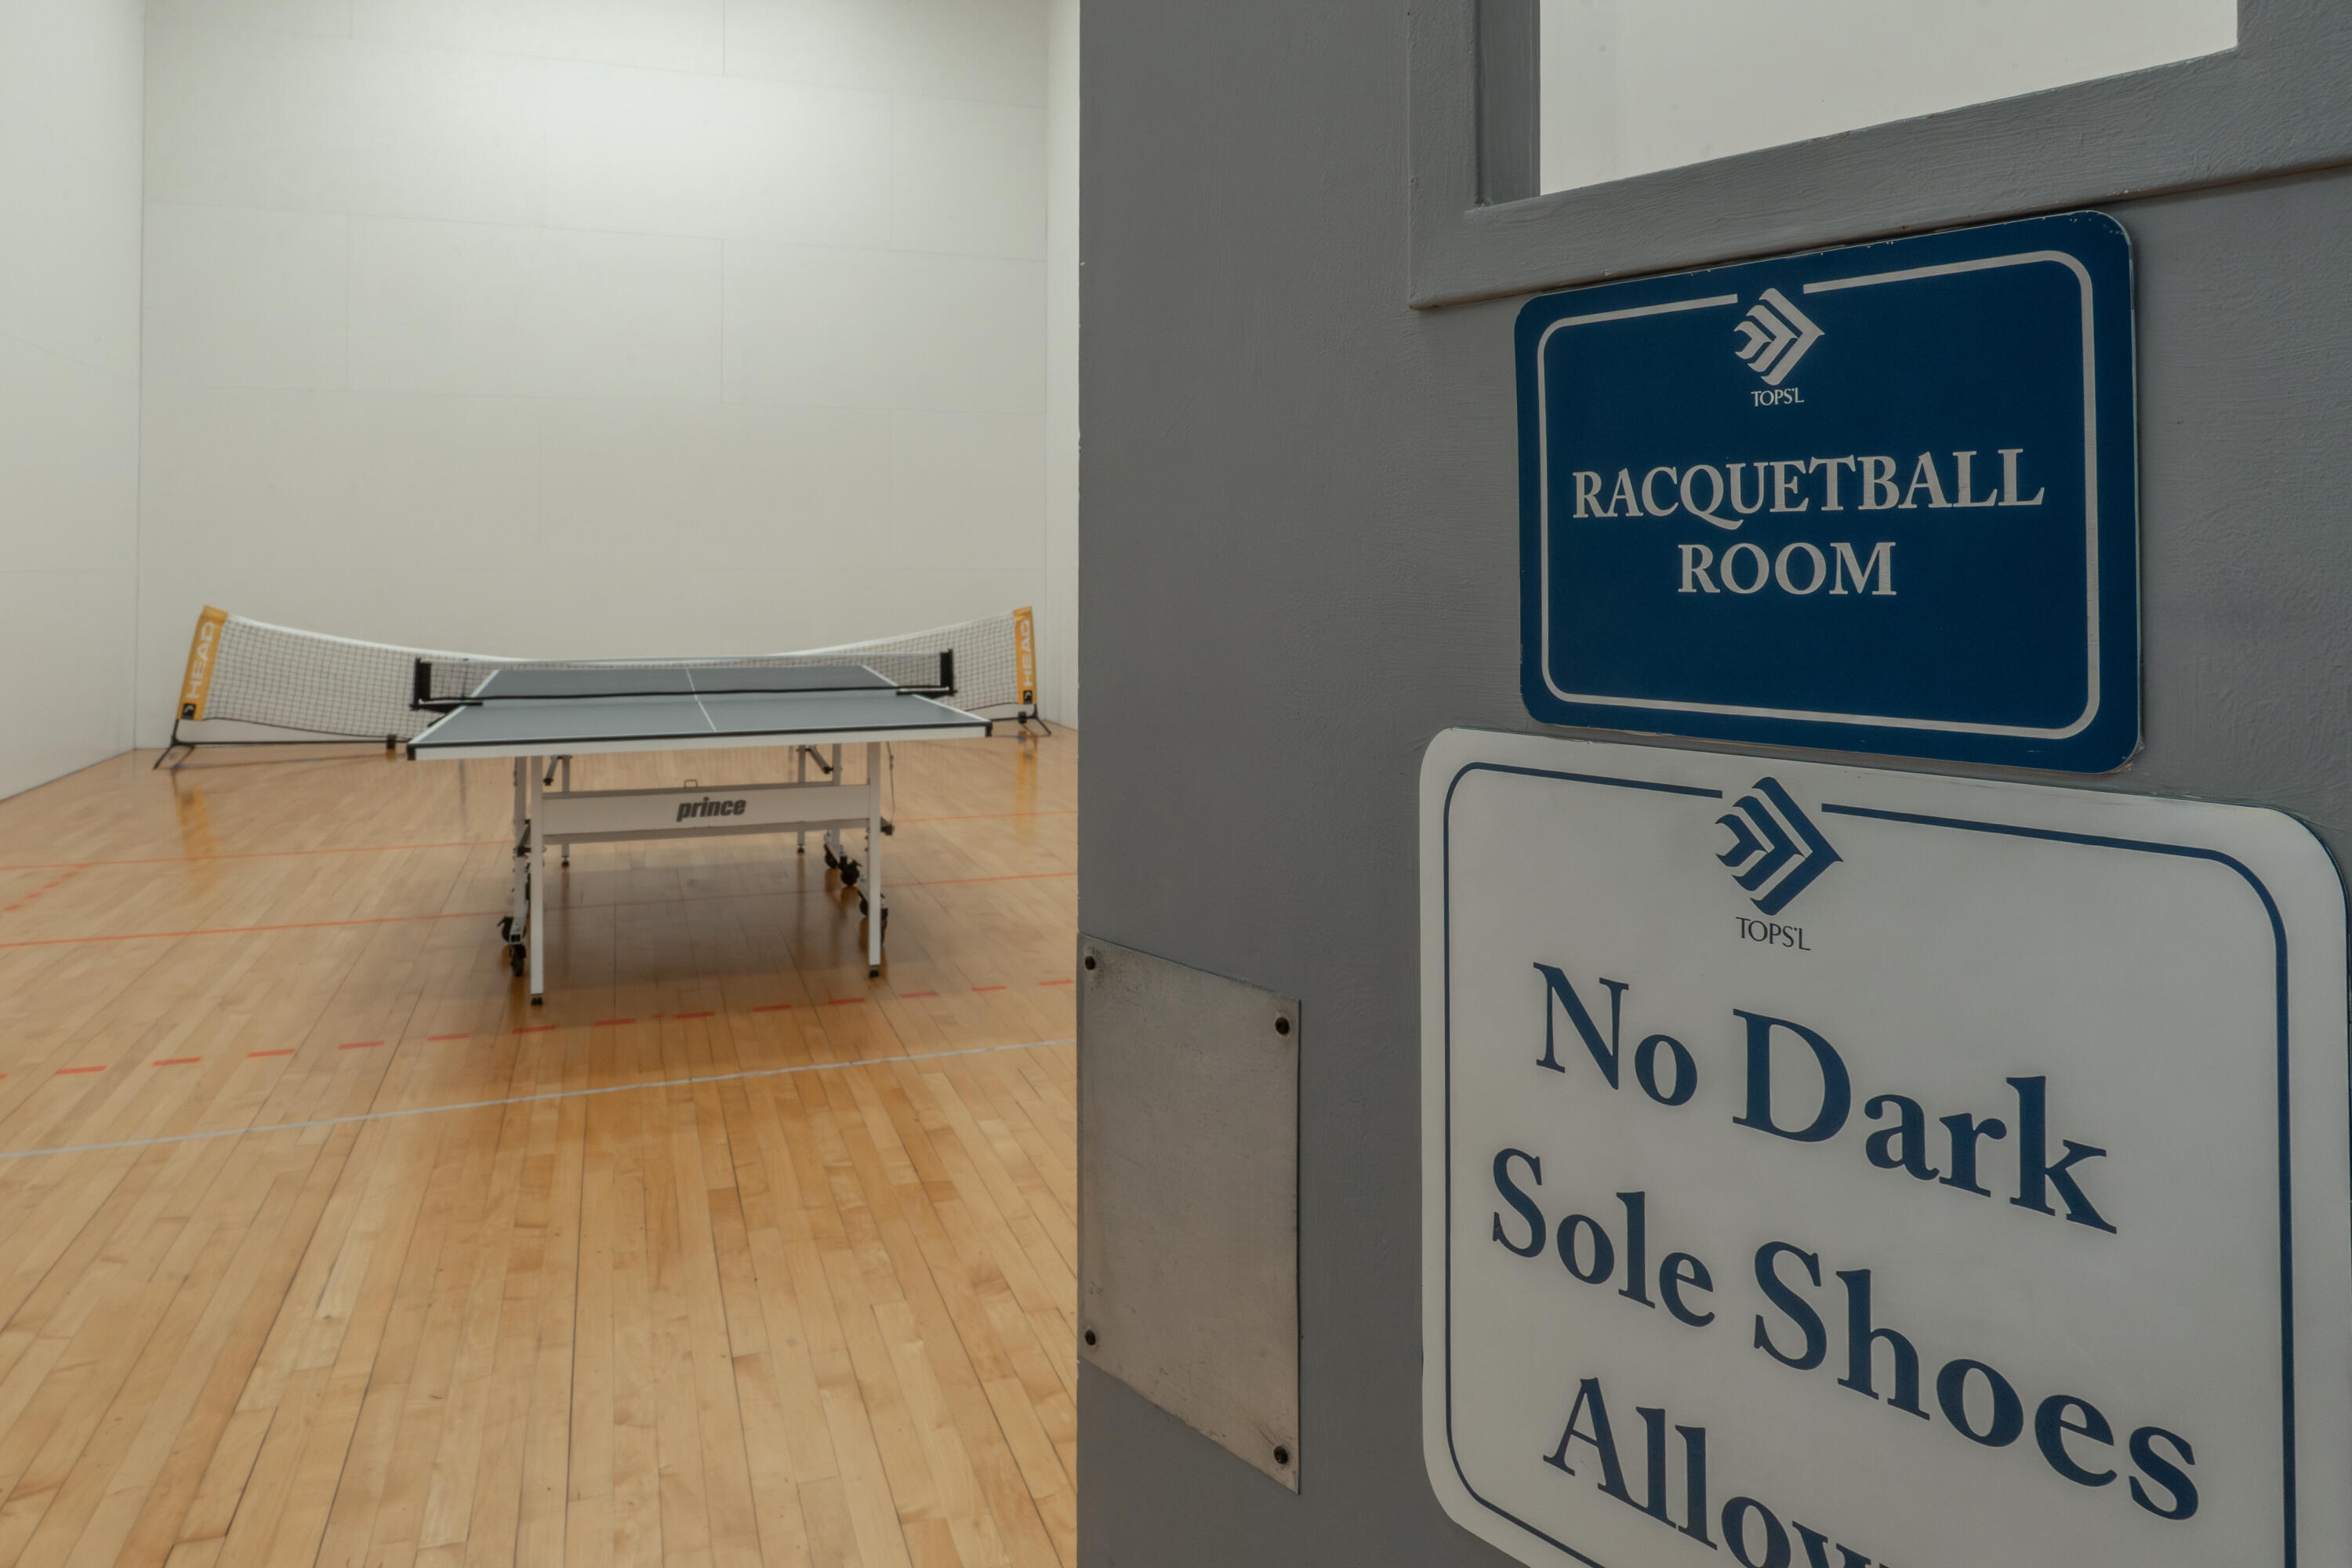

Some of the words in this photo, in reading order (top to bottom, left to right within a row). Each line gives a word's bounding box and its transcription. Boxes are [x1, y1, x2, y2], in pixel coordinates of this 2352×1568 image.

[1572, 448, 2045, 530] RACQUETBALL
[1677, 541, 1897, 597] ROOM
[186, 622, 215, 699] HEAD
[1021, 619, 1033, 686] HEAD
[676, 797, 746, 822] prince
[1533, 962, 1698, 1107] No
[1732, 1007, 2118, 1235] Dark
[1492, 1148, 1715, 1328] Sole
[1754, 1240, 2200, 1521] Shoes
